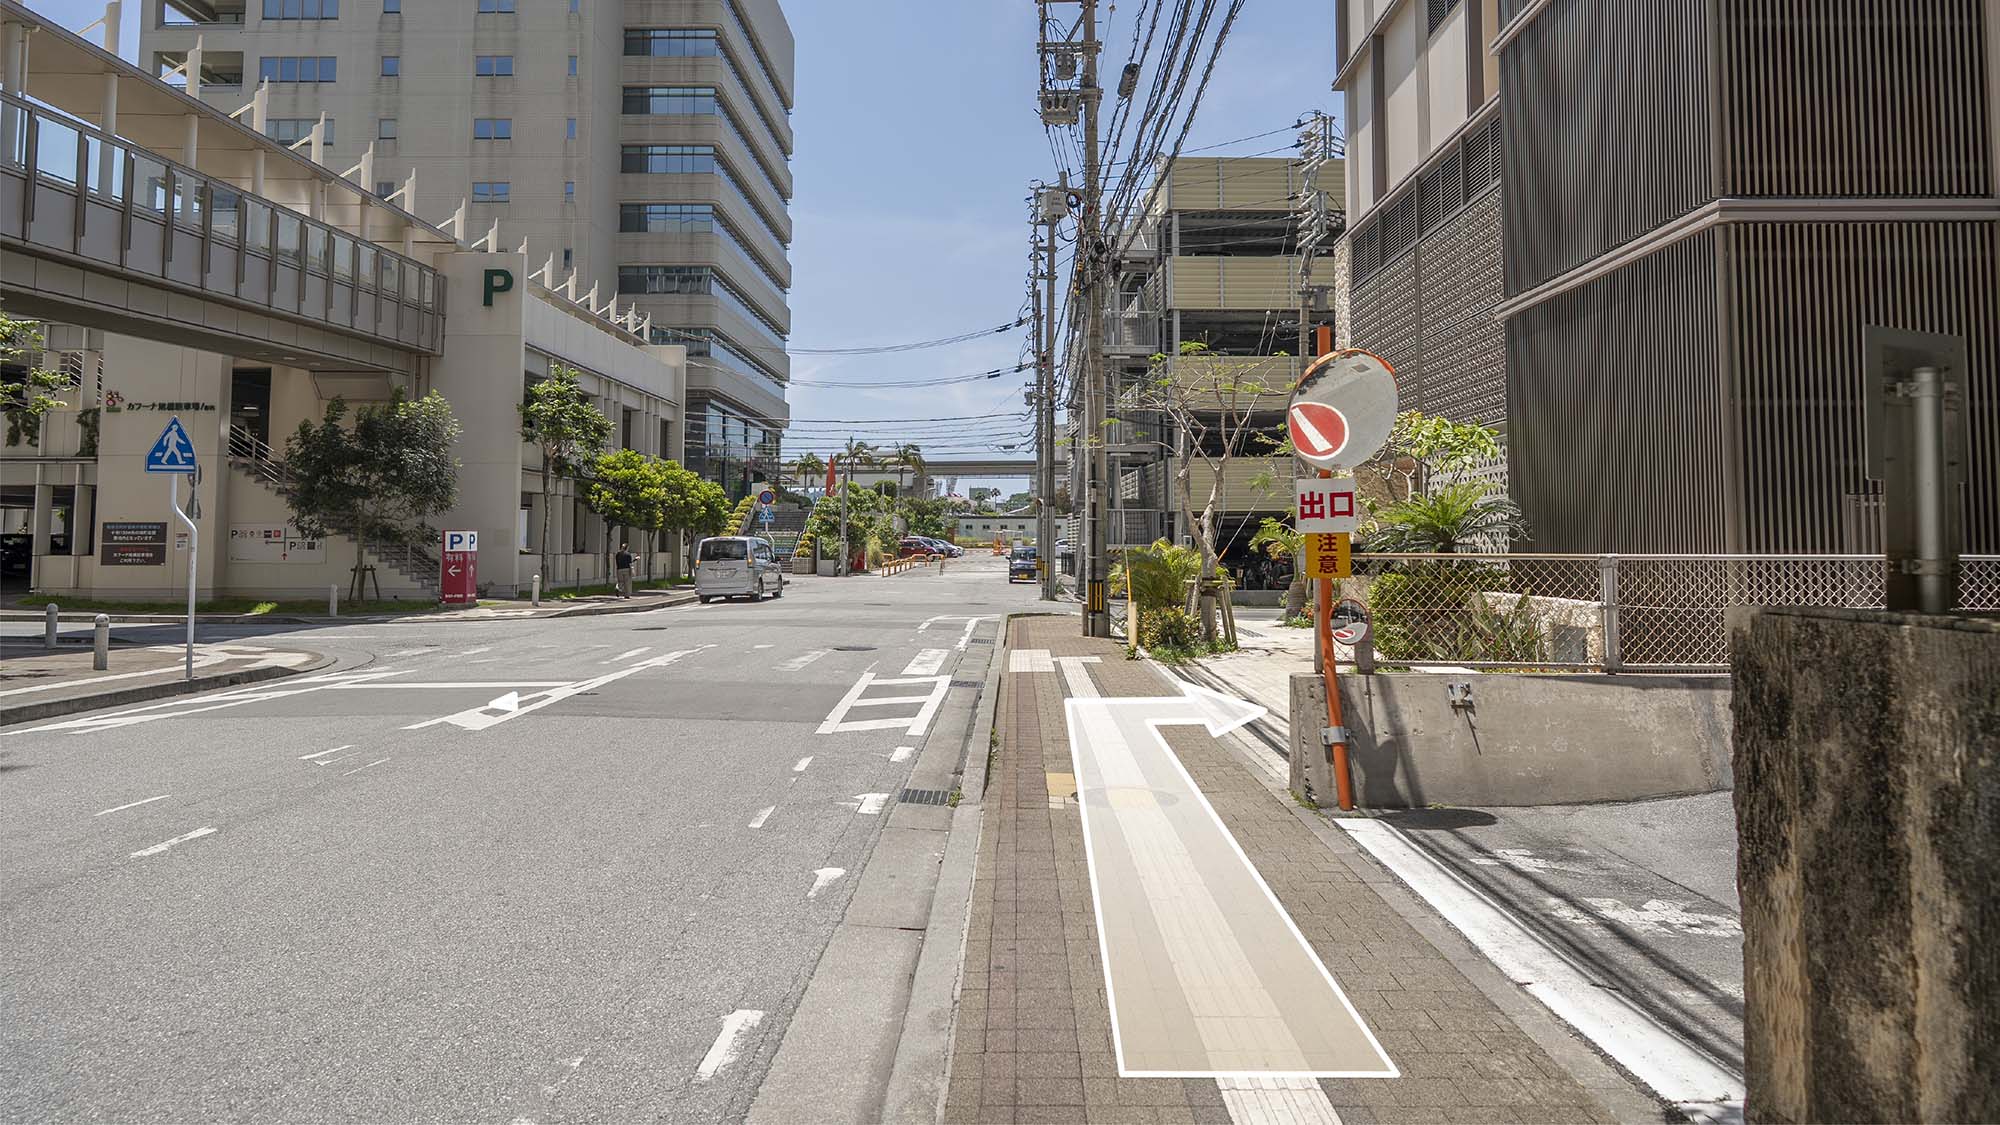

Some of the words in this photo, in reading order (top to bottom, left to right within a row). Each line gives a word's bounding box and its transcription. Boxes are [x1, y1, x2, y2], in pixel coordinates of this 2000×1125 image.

[483, 269, 514, 307] P
[1300, 491, 1354, 520] 出口
[231, 530, 238, 539] P
[450, 534, 463, 549] P
[469, 534, 475, 549] P
[289, 541, 297, 551] P
[1318, 533, 1338, 574] 注意
